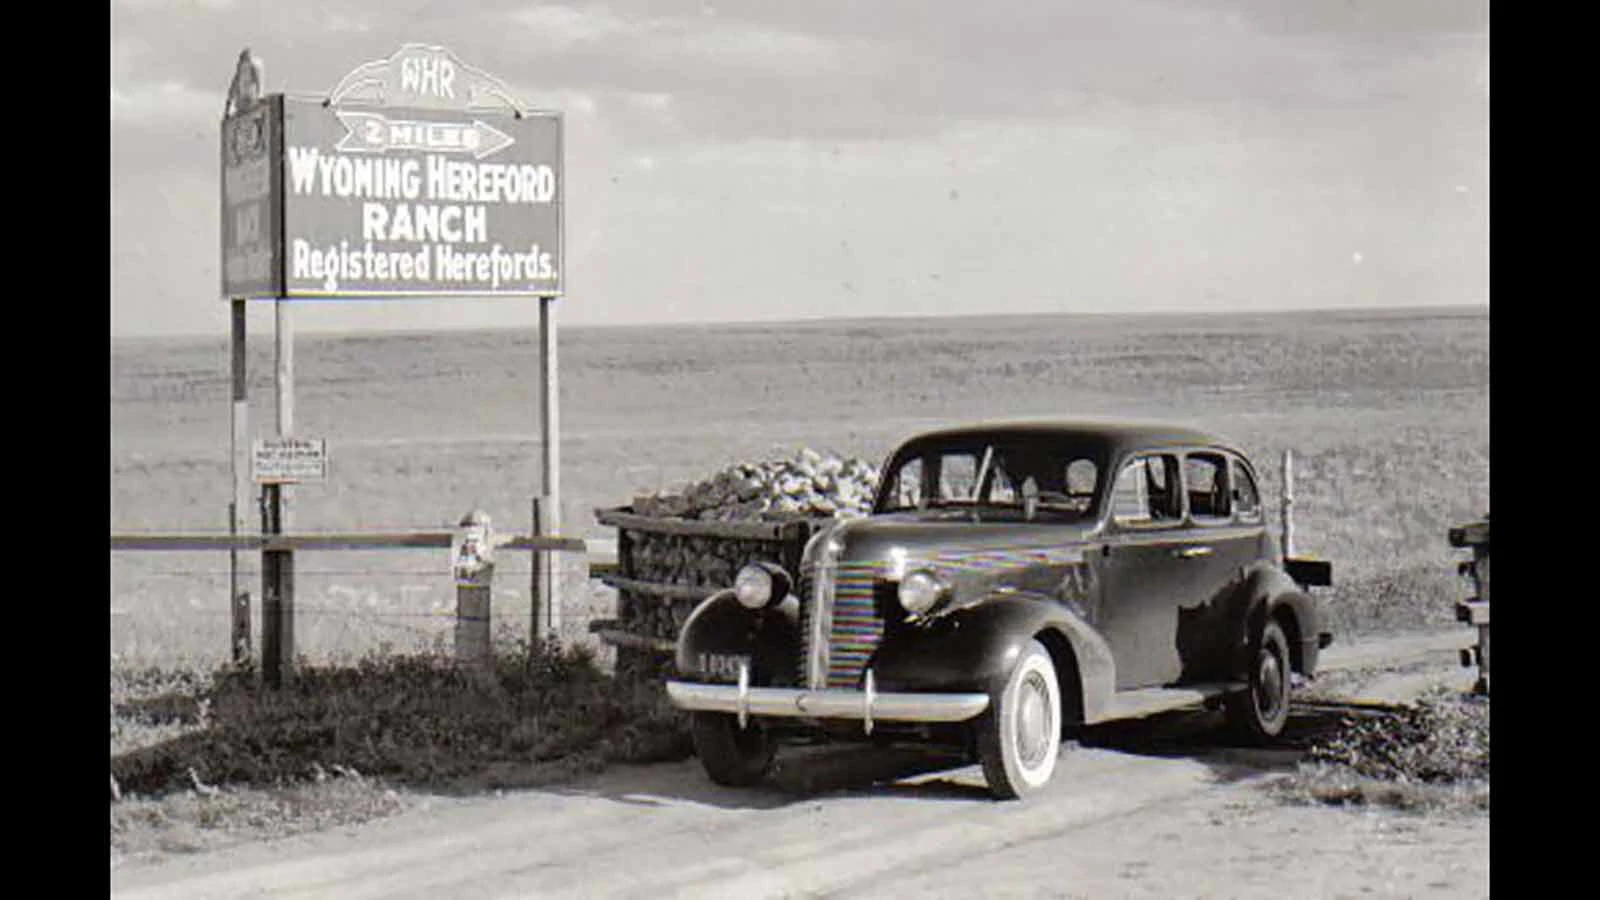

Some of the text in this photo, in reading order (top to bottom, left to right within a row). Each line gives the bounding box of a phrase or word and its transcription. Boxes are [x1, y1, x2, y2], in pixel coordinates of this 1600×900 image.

[402, 56, 455, 98] WHR
[366, 121, 382, 141] 2
[289, 147, 421, 198] WYOMING
[428, 156, 554, 202] HEREFORD
[363, 204, 486, 242] RANCH
[293, 240, 429, 291] Registered
[437, 245, 557, 287] Herefords.
